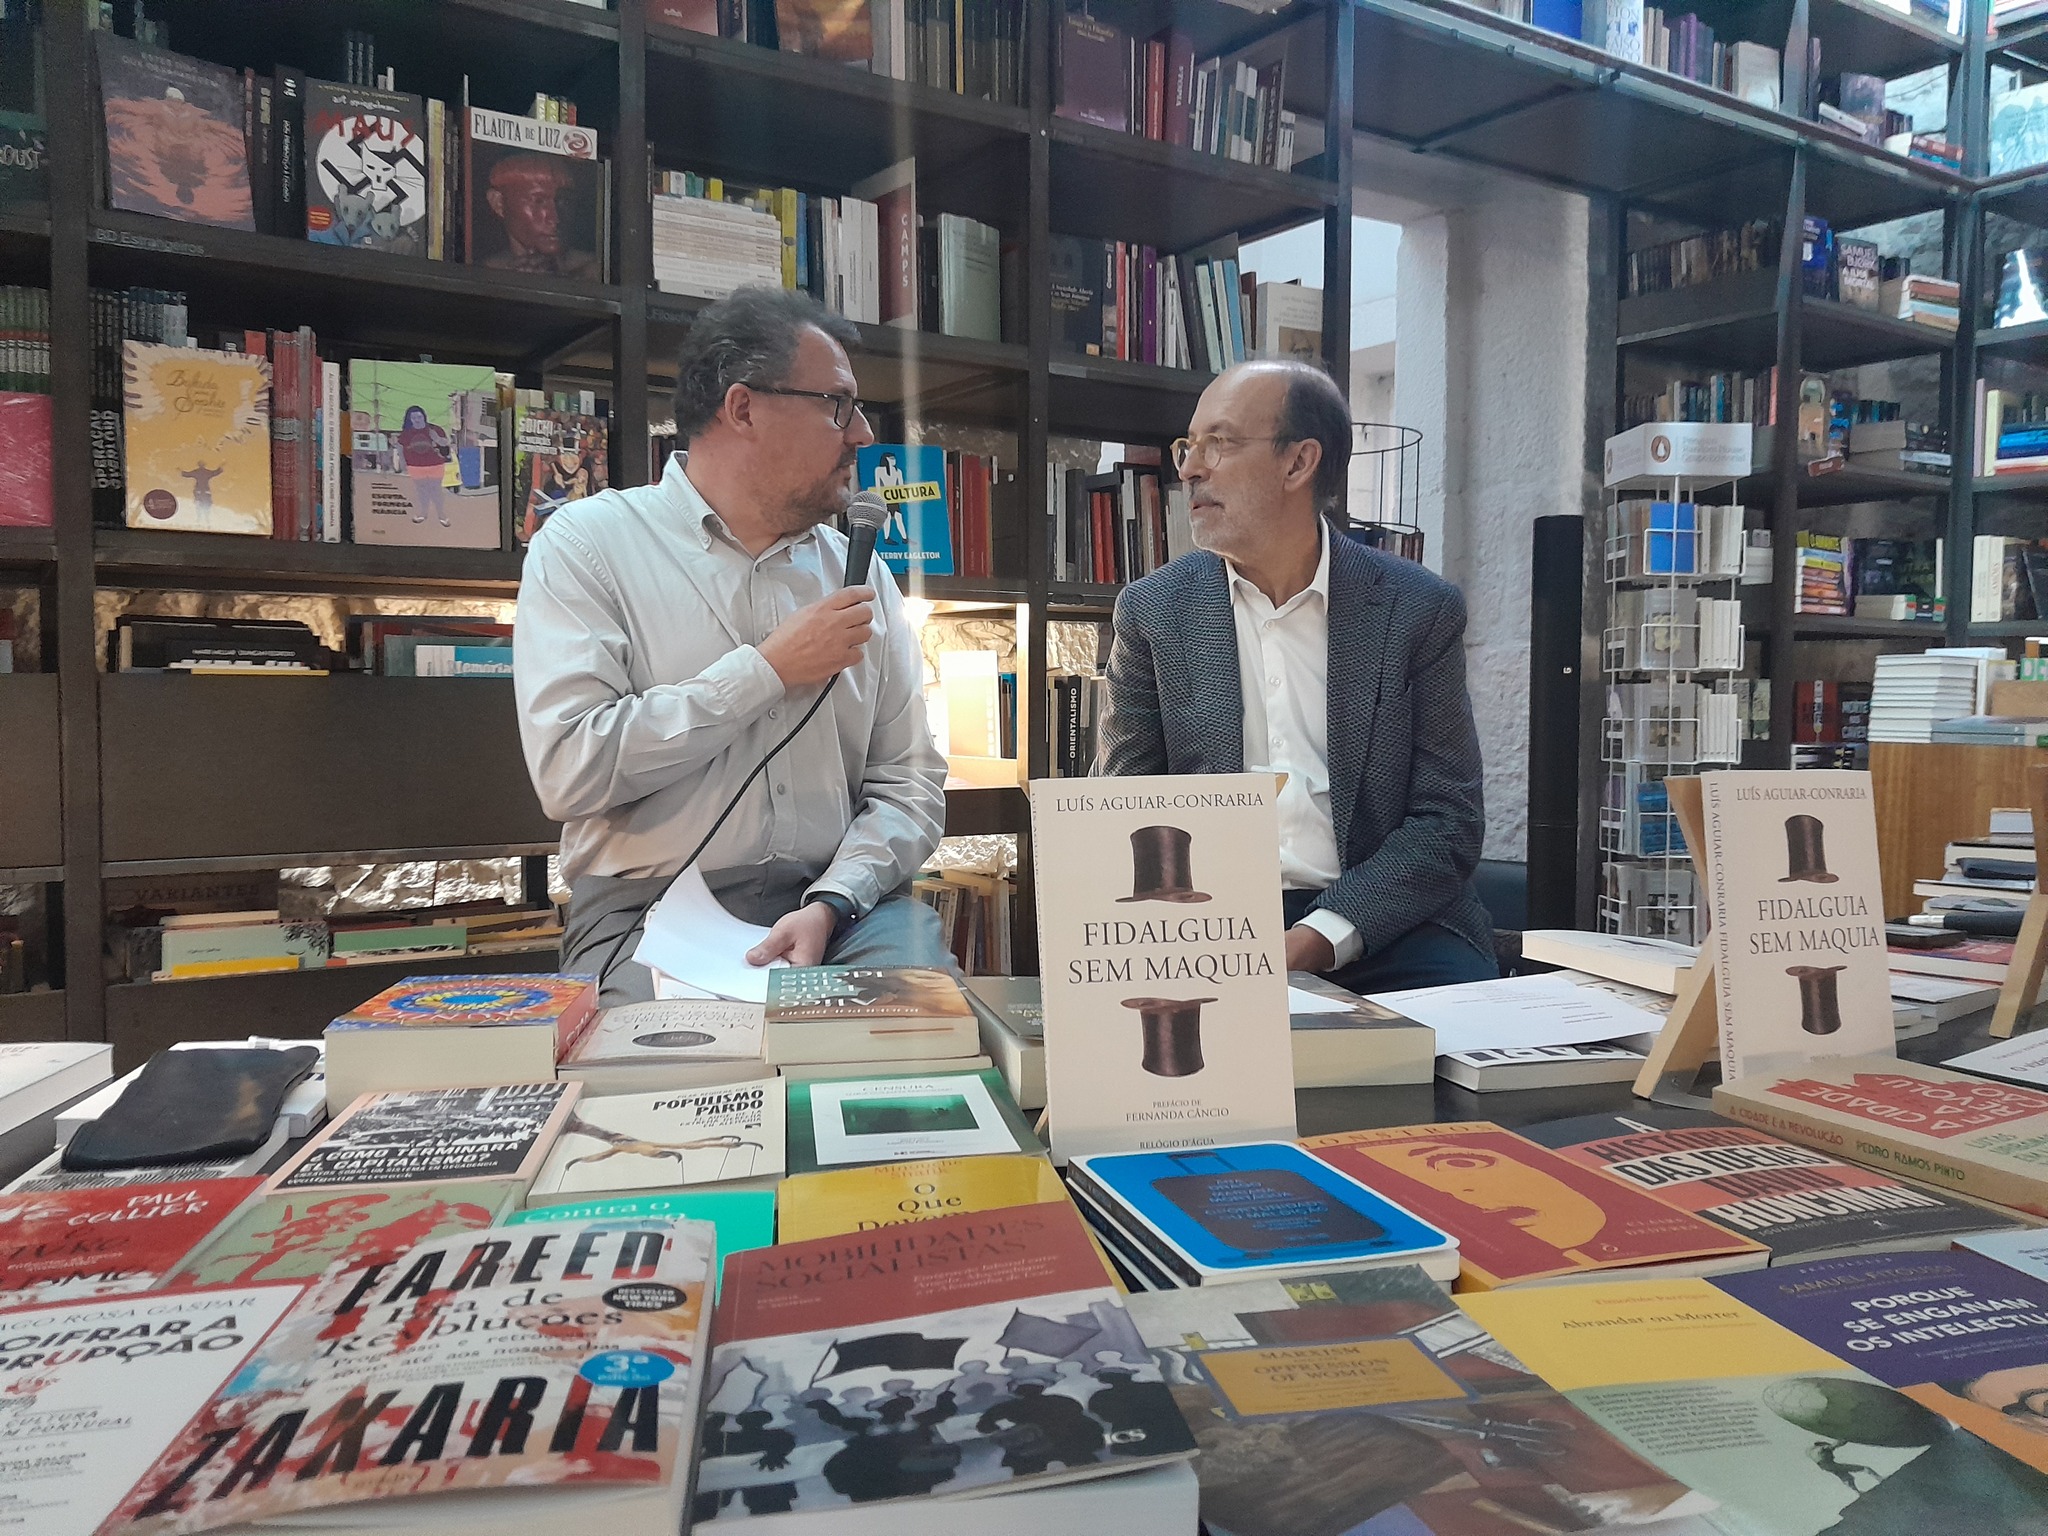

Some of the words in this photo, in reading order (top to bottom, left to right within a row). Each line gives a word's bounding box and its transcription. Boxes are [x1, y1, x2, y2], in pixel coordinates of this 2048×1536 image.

[308, 110, 416, 148] MAUS
[474, 113, 522, 142] FLAUTA
[525, 127, 535, 141] DE
[538, 125, 561, 150] LUZ
[0, 143, 42, 171] OUST
[883, 485, 936, 501] CULTURA
[880, 551, 903, 560] TERRY
[904, 551, 941, 560] EAGLETON
[1069, 687, 1077, 759] ORIENTALISMO
[1056, 794, 1094, 813] LUÍS
[1099, 792, 1265, 811] AGUIAR-CONRARIA
[1709, 782, 1721, 808] LUÍS
[1736, 785, 1761, 801] LUÍS
[1764, 787, 1868, 801] AGUIAR-CONRARIA
[1711, 811, 1726, 928] AGUIAR-CONRARIA
[1757, 895, 1868, 921] FIDALGUIA
[1083, 916, 1258, 947] FIDALGUIA
[1750, 930, 1792, 954] SEM
[1799, 926, 1880, 954] MAQUIA
[1068, 958, 1133, 985] SEM
[1144, 952, 1275, 985] MAQUIA
[1719, 932, 1731, 998] FIDALGUIA
[1723, 1002, 1733, 1027] SEM
[1726, 1031, 1737, 1081] MAQUIA
[652, 1089, 764, 1111] POPULISMO
[695, 1099, 763, 1116] PARDO
[1152, 1099, 1190, 1109] PREFÁCIO
[1191, 1099, 1202, 1107] DE
[1800, 1086, 1927, 1123] CIDADE
[1126, 1111, 1184, 1122] FERNANDA
[1187, 1107, 1230, 1119] CÂNCIO
[1614, 1116, 1661, 1134] A
[1139, 1139, 1180, 1150] RELÓGIO
[1302, 1121, 1494, 1149] ONSTROS
[1584, 1128, 1768, 1163] HISTÓRIA
[1729, 1105, 1737, 1116] A
[1739, 1108, 1770, 1127] CIDADE
[1779, 1119, 1787, 1129] A
[1788, 1122, 1844, 1146] REVOLUÇÃO
[1855, 1141, 1889, 1159] PEDRO
[1893, 1151, 1931, 1171] RAMOS
[1933, 1161, 1965, 1181] PINTO
[300, 1163, 324, 1172] EL
[333, 1152, 491, 1170] CAPITALISMO?
[338, 1168, 369, 1176] SOBRE
[386, 1165, 426, 1173] SISTEMA
[442, 1160, 499, 1170] DECADENCIA
[1616, 1148, 1712, 1187] DAS
[1707, 1143, 1833, 1175] IDEIAS
[914, 1183, 936, 1195] O
[1701, 1166, 1846, 1199] DAVID
[126, 1189, 201, 1208] PAUL
[897, 1196, 963, 1214] Que
[1705, 1185, 1945, 1230] RUNCIMAN
[67, 1200, 209, 1226] COLLIER
[523, 1203, 637, 1223] Contra
[650, 1202, 671, 1210] o
[758, 1218, 1045, 1273] MOBILIDADES
[333, 1229, 667, 1314] FAREED
[756, 1238, 1028, 1290] SOCIALISTAS
[618, 1288, 675, 1296] BESTSELLER
[1778, 1274, 1863, 1295] SAMUEL
[503, 1288, 564, 1308] de
[1850, 1285, 1976, 1313] PORQUE
[64, 1308, 136, 1325] ROSA
[147, 1297, 256, 1316] GASPAR
[199, 1314, 237, 1332] A
[1563, 1315, 1646, 1329] Abrandar
[1650, 1315, 1672, 1323] ou
[1675, 1311, 1741, 1321] Morrer
[1842, 1316, 1886, 1333] SE
[1882, 1297, 2040, 1327] ENGANAM
[0, 1333, 244, 1372] RUPÇÃO
[446, 1351, 480, 1360] aos
[494, 1345, 563, 1356] nossos
[457, 1339, 469, 1347] e
[1260, 1346, 1361, 1360] MARXISM
[1846, 1336, 1893, 1352] OS
[1253, 1357, 1390, 1375] OPPRESSION
[1270, 1372, 1298, 1382] OF
[1307, 1366, 1390, 1380] WOMEN
[134, 1373, 661, 1521] ZAKARIA
[1102, 1428, 1147, 1445] ICS
